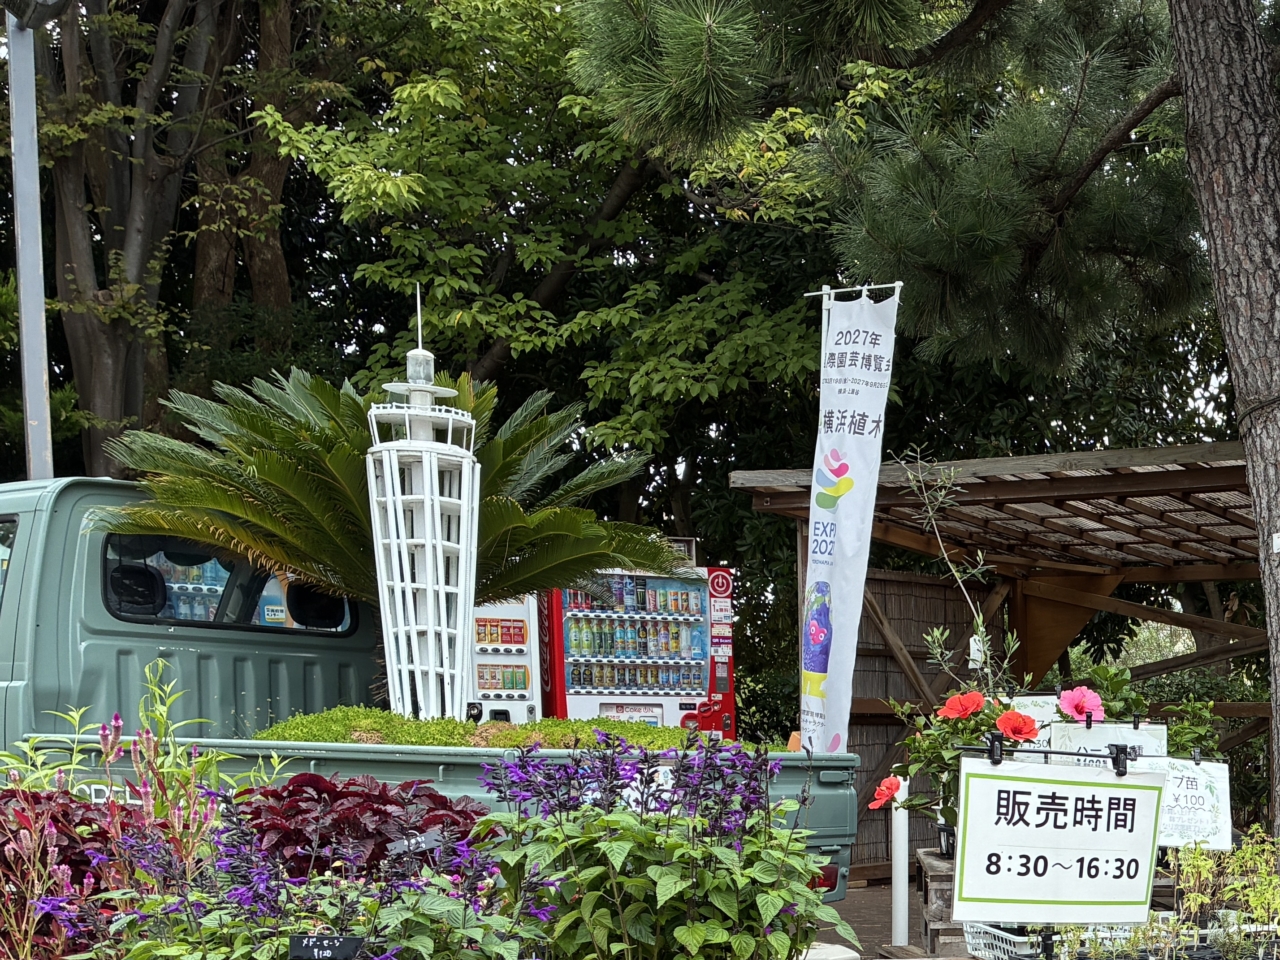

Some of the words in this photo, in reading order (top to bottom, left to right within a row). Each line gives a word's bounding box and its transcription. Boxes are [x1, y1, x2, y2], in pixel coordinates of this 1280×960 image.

[834, 329, 882, 349] 2027年
[811, 538, 835, 556] 202
[624, 706, 642, 714] Coke
[1172, 793, 1205, 806] ¥100
[994, 789, 1136, 833] 販売時間
